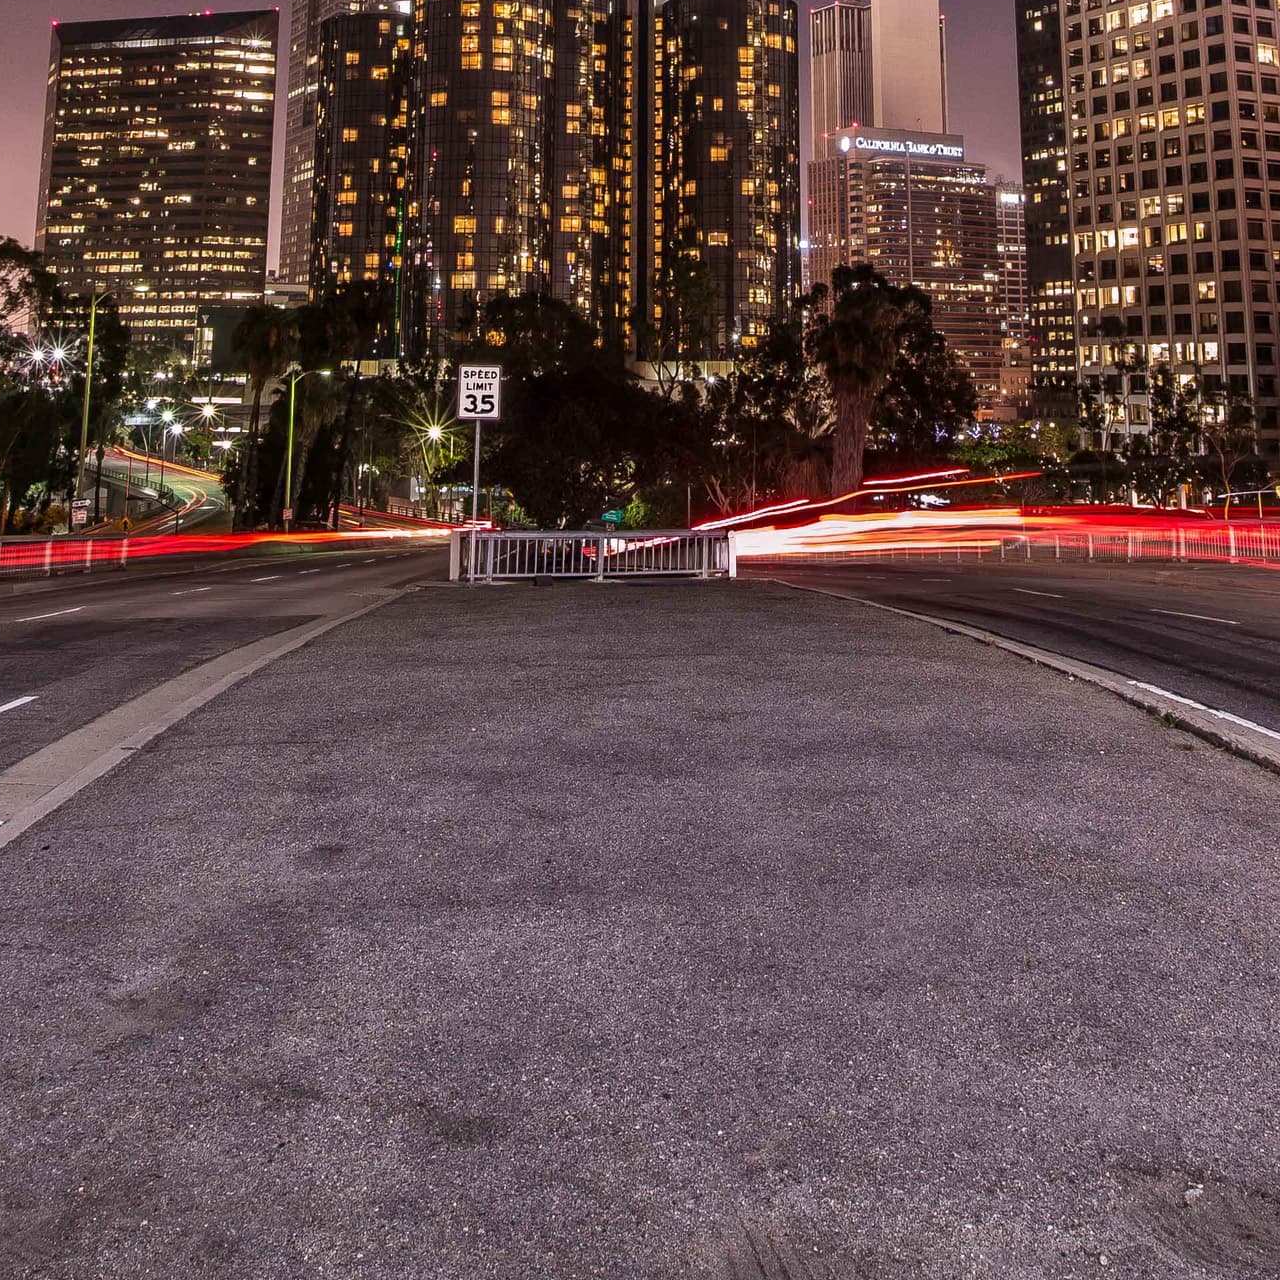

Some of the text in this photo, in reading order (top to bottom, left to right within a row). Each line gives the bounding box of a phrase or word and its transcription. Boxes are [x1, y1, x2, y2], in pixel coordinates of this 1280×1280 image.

[855, 137, 906, 152] CALIFORNIA
[935, 143, 963, 157] TRUST
[463, 370, 497, 379] SPEED
[466, 382, 493, 391] LIMIT
[464, 394, 495, 414] 35
